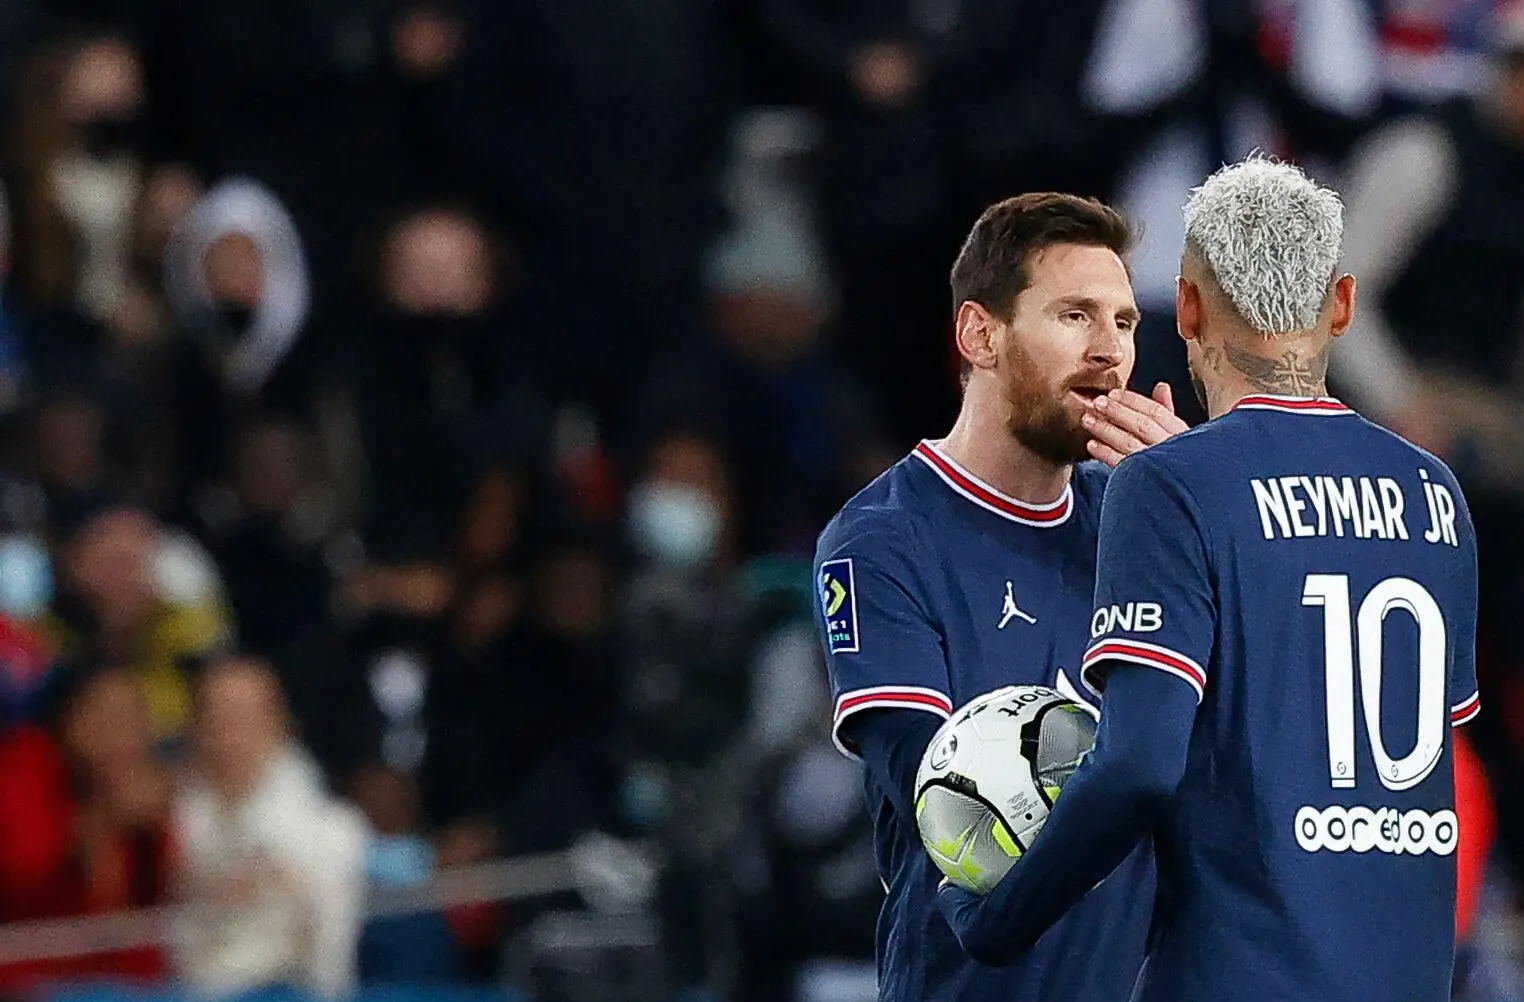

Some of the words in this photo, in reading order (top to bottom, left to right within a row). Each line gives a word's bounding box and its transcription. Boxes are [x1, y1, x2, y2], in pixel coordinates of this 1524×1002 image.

[1251, 475, 1411, 541] NEYMAR
[1091, 602, 1163, 638] QNB
[1302, 574, 1446, 791] 10
